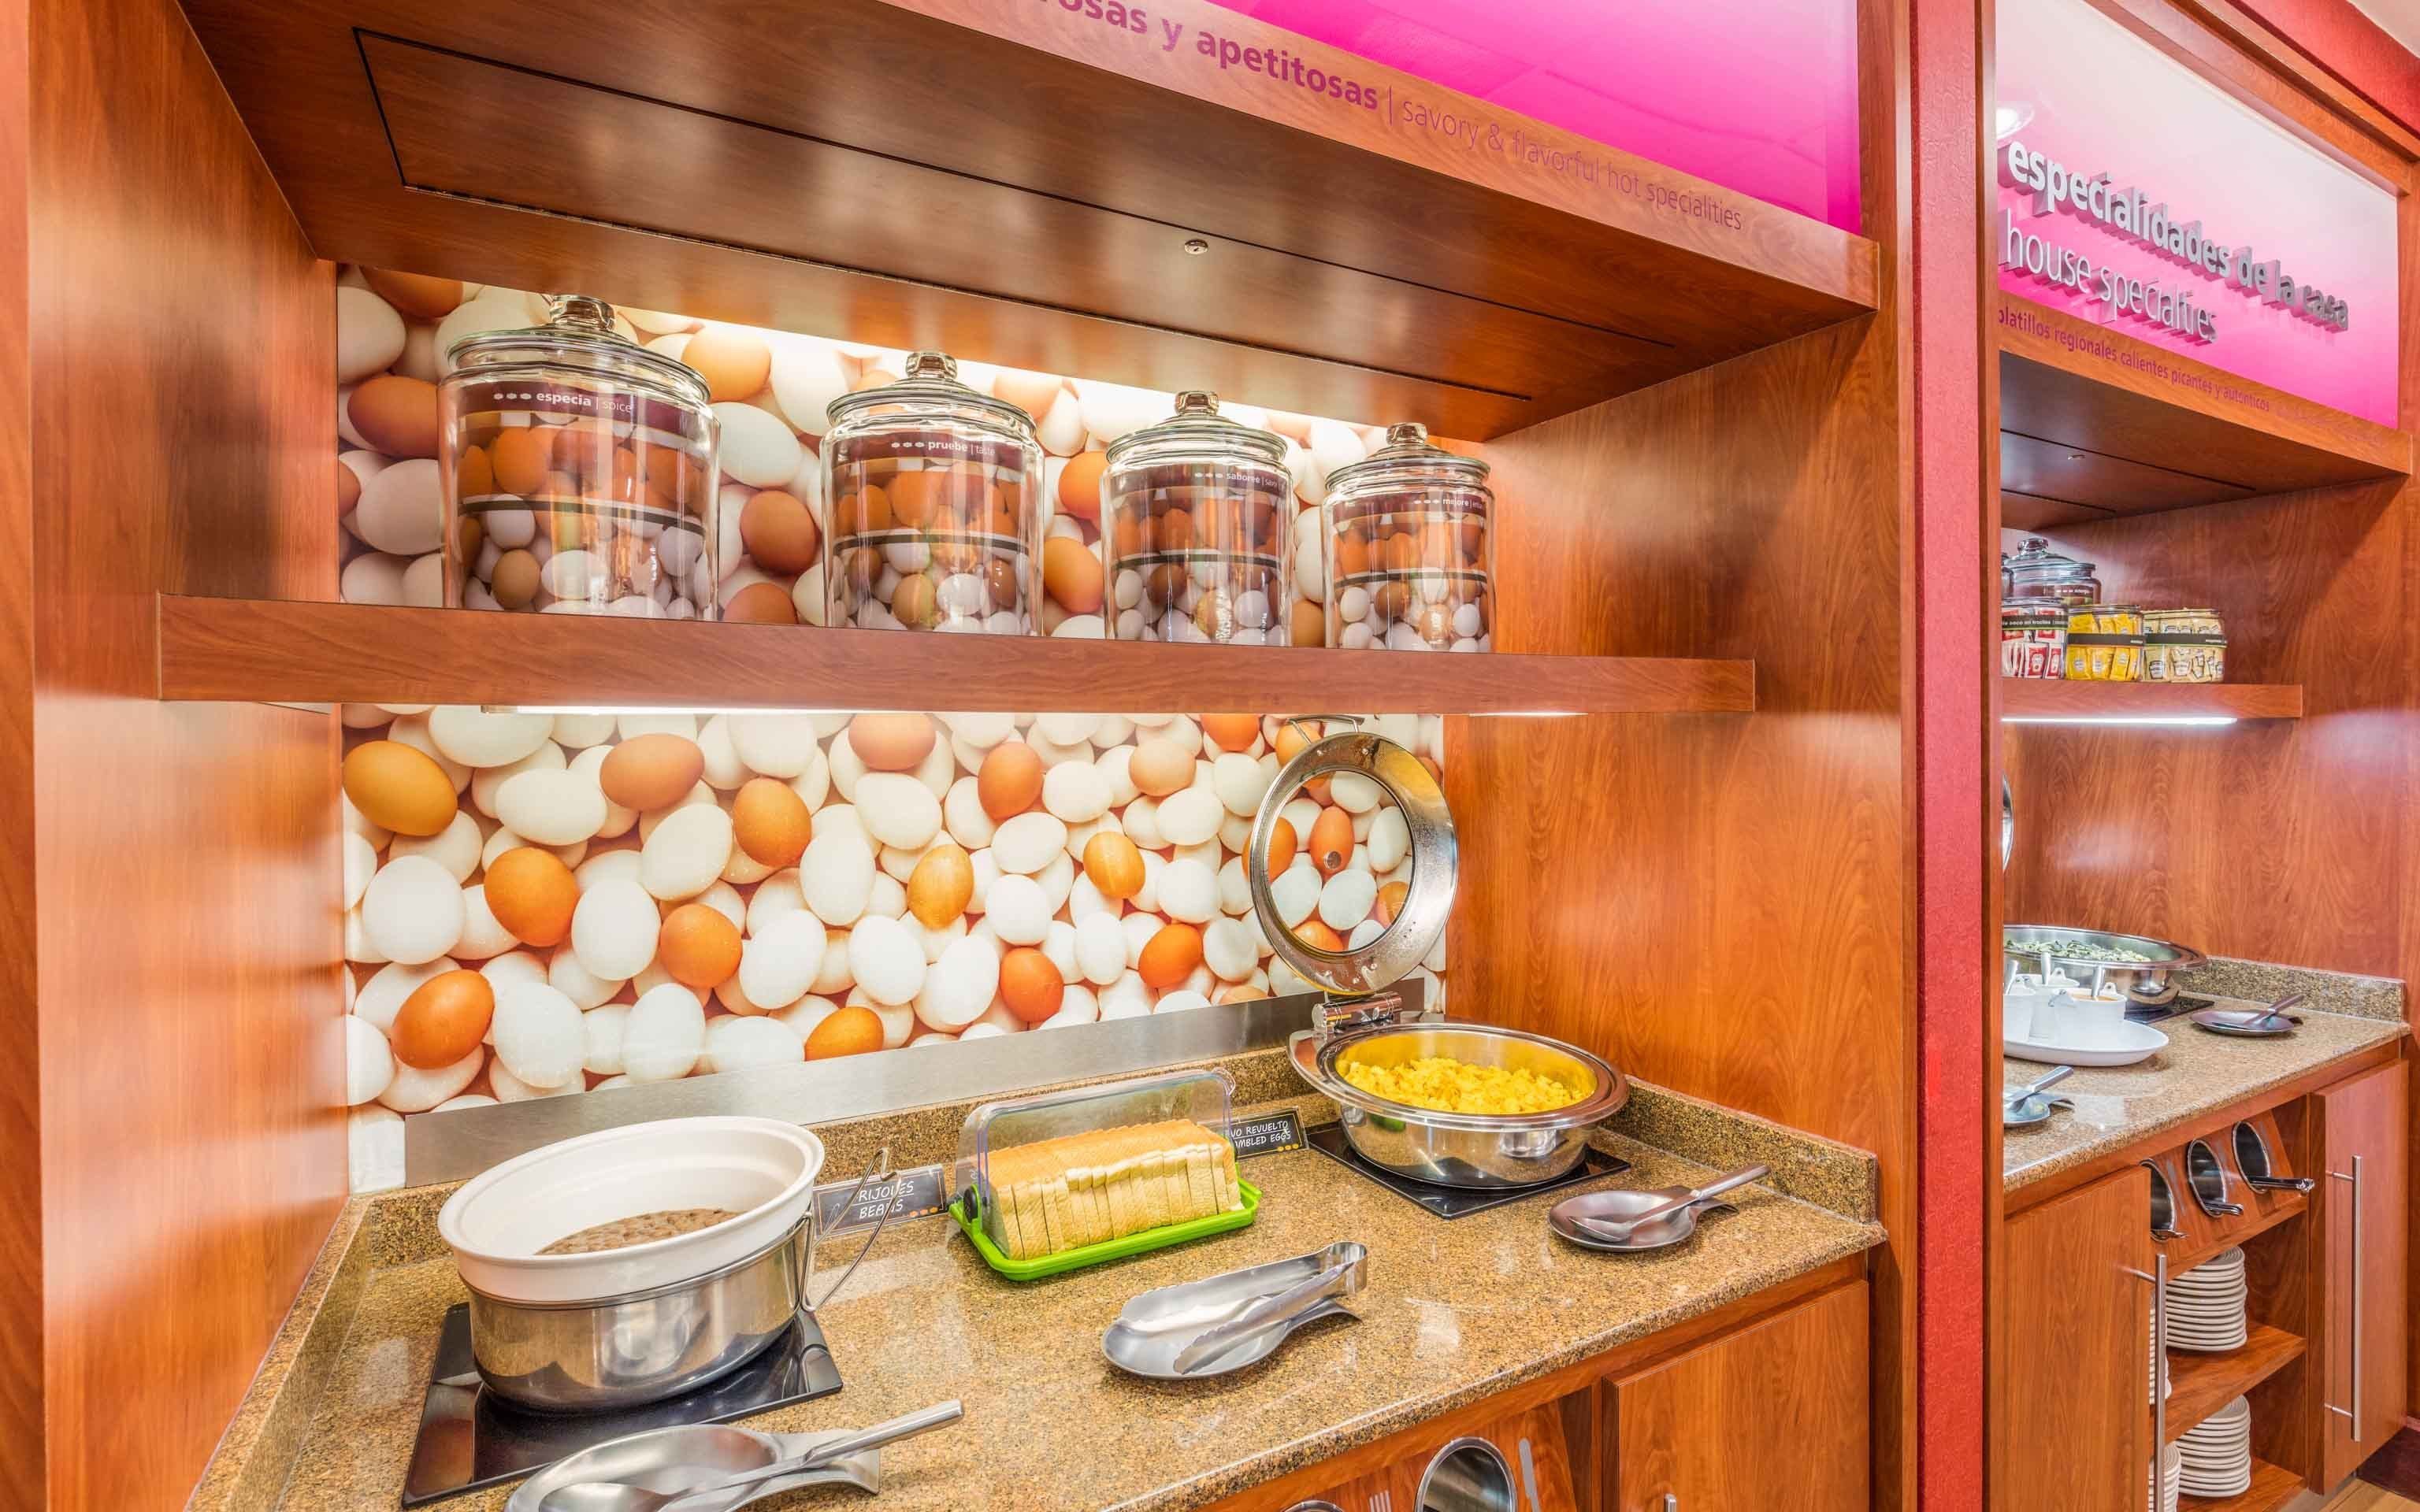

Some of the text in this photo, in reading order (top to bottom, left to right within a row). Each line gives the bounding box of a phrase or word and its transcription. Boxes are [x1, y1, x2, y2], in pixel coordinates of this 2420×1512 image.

[1161, 18, 1183, 52] y
[1197, 30, 1378, 111] apetitosas
[1403, 101, 1479, 150] savory
[1487, 123, 1504, 152] &
[1512, 130, 1600, 183] flavorful
[1608, 161, 1641, 198] hot
[1646, 183, 1742, 230] specialities
[2008, 141, 2350, 332] especialidades de la casa
[2007, 207, 2218, 345] house specialties
[2054, 328, 2118, 362] regionales
[2121, 351, 2168, 380] calientes
[2171, 368, 2213, 395] picantes
[2215, 383, 2221, 401] y
[536, 393, 633, 413] especia spice
[928, 441, 968, 452] pruebe
[1246, 1121, 1288, 1135] REVUELTO
[1271, 1130, 1291, 1143] EGGS
